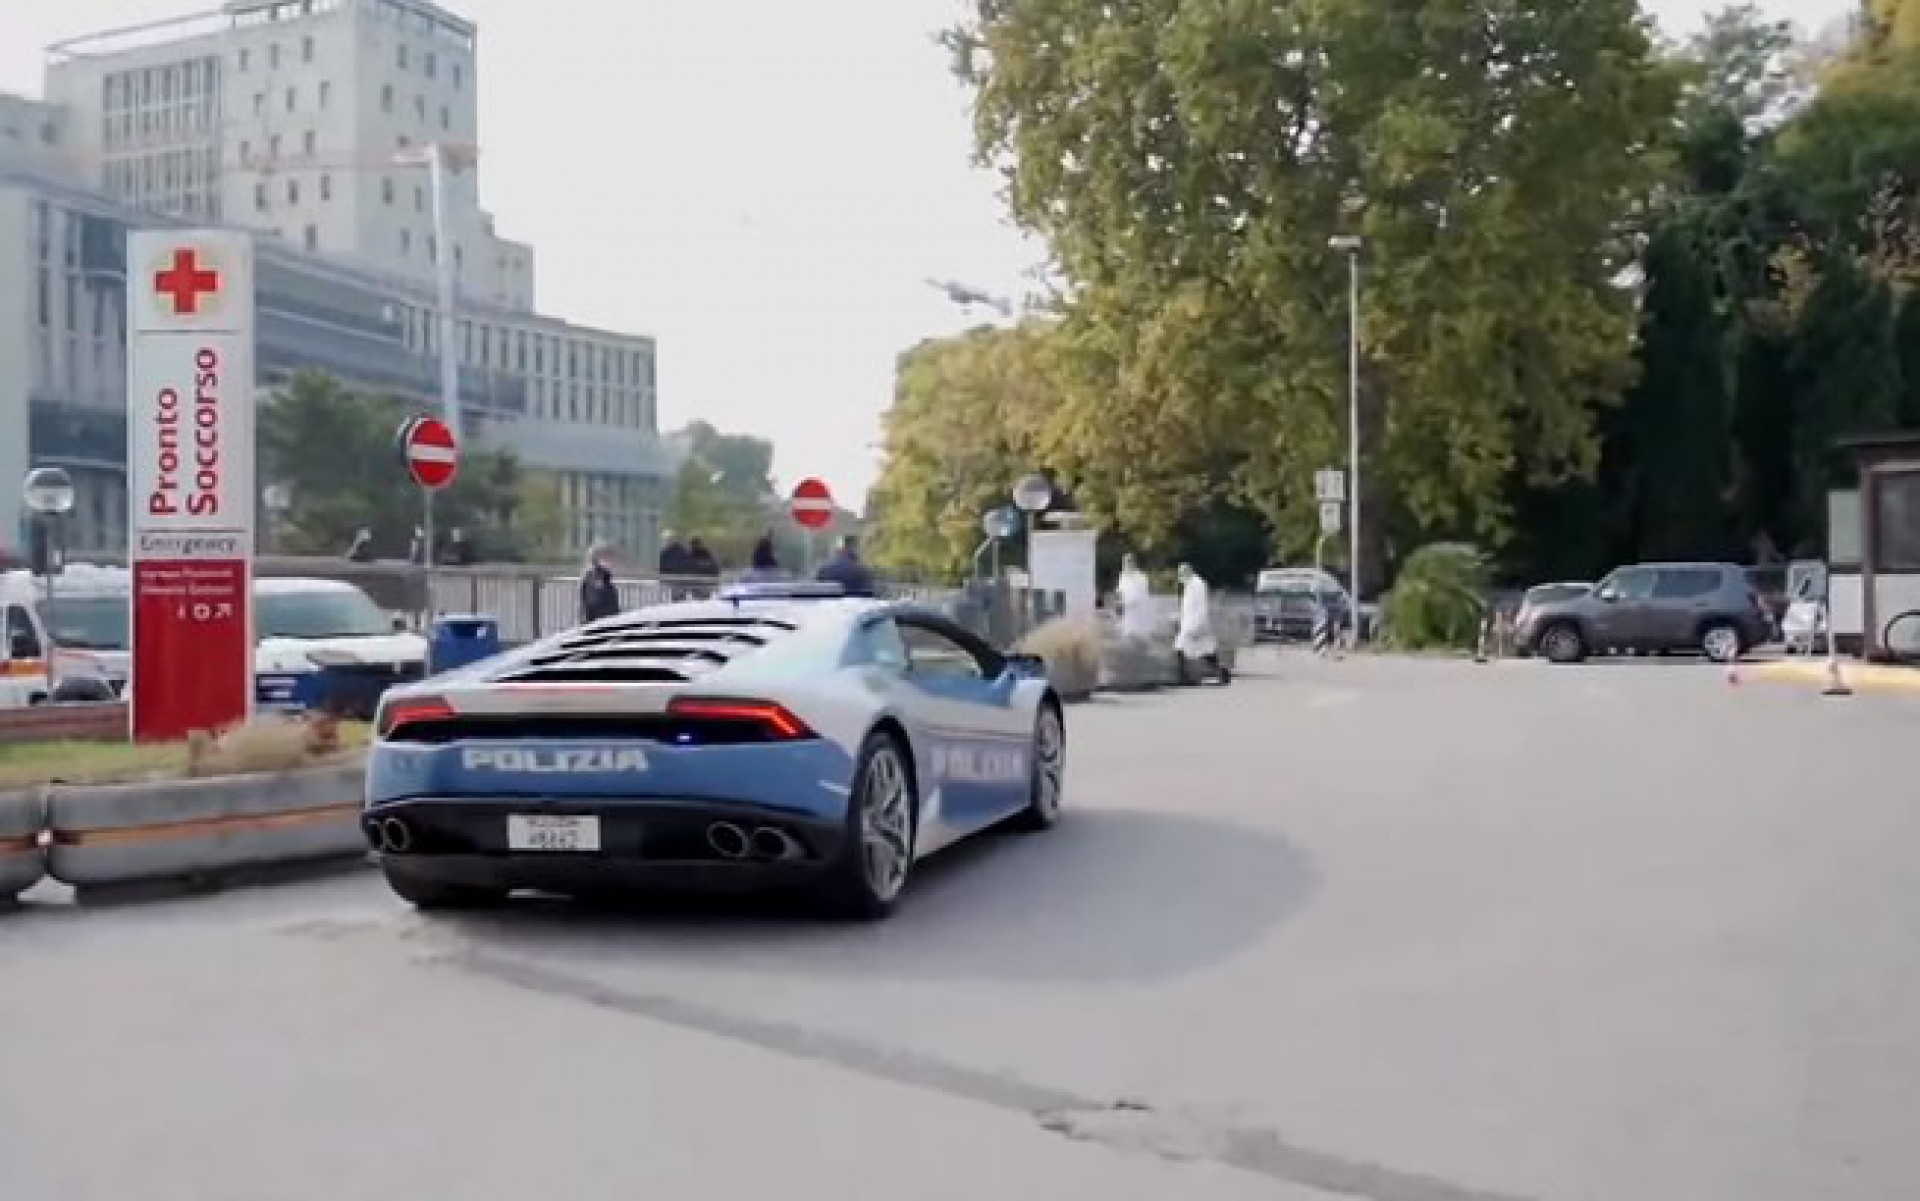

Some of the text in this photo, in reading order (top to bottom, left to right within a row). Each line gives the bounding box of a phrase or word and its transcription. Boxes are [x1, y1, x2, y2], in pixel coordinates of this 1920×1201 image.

[149, 388, 177, 515] Pronto
[187, 347, 219, 516] Soccorso
[462, 747, 649, 772] POLIZIA
